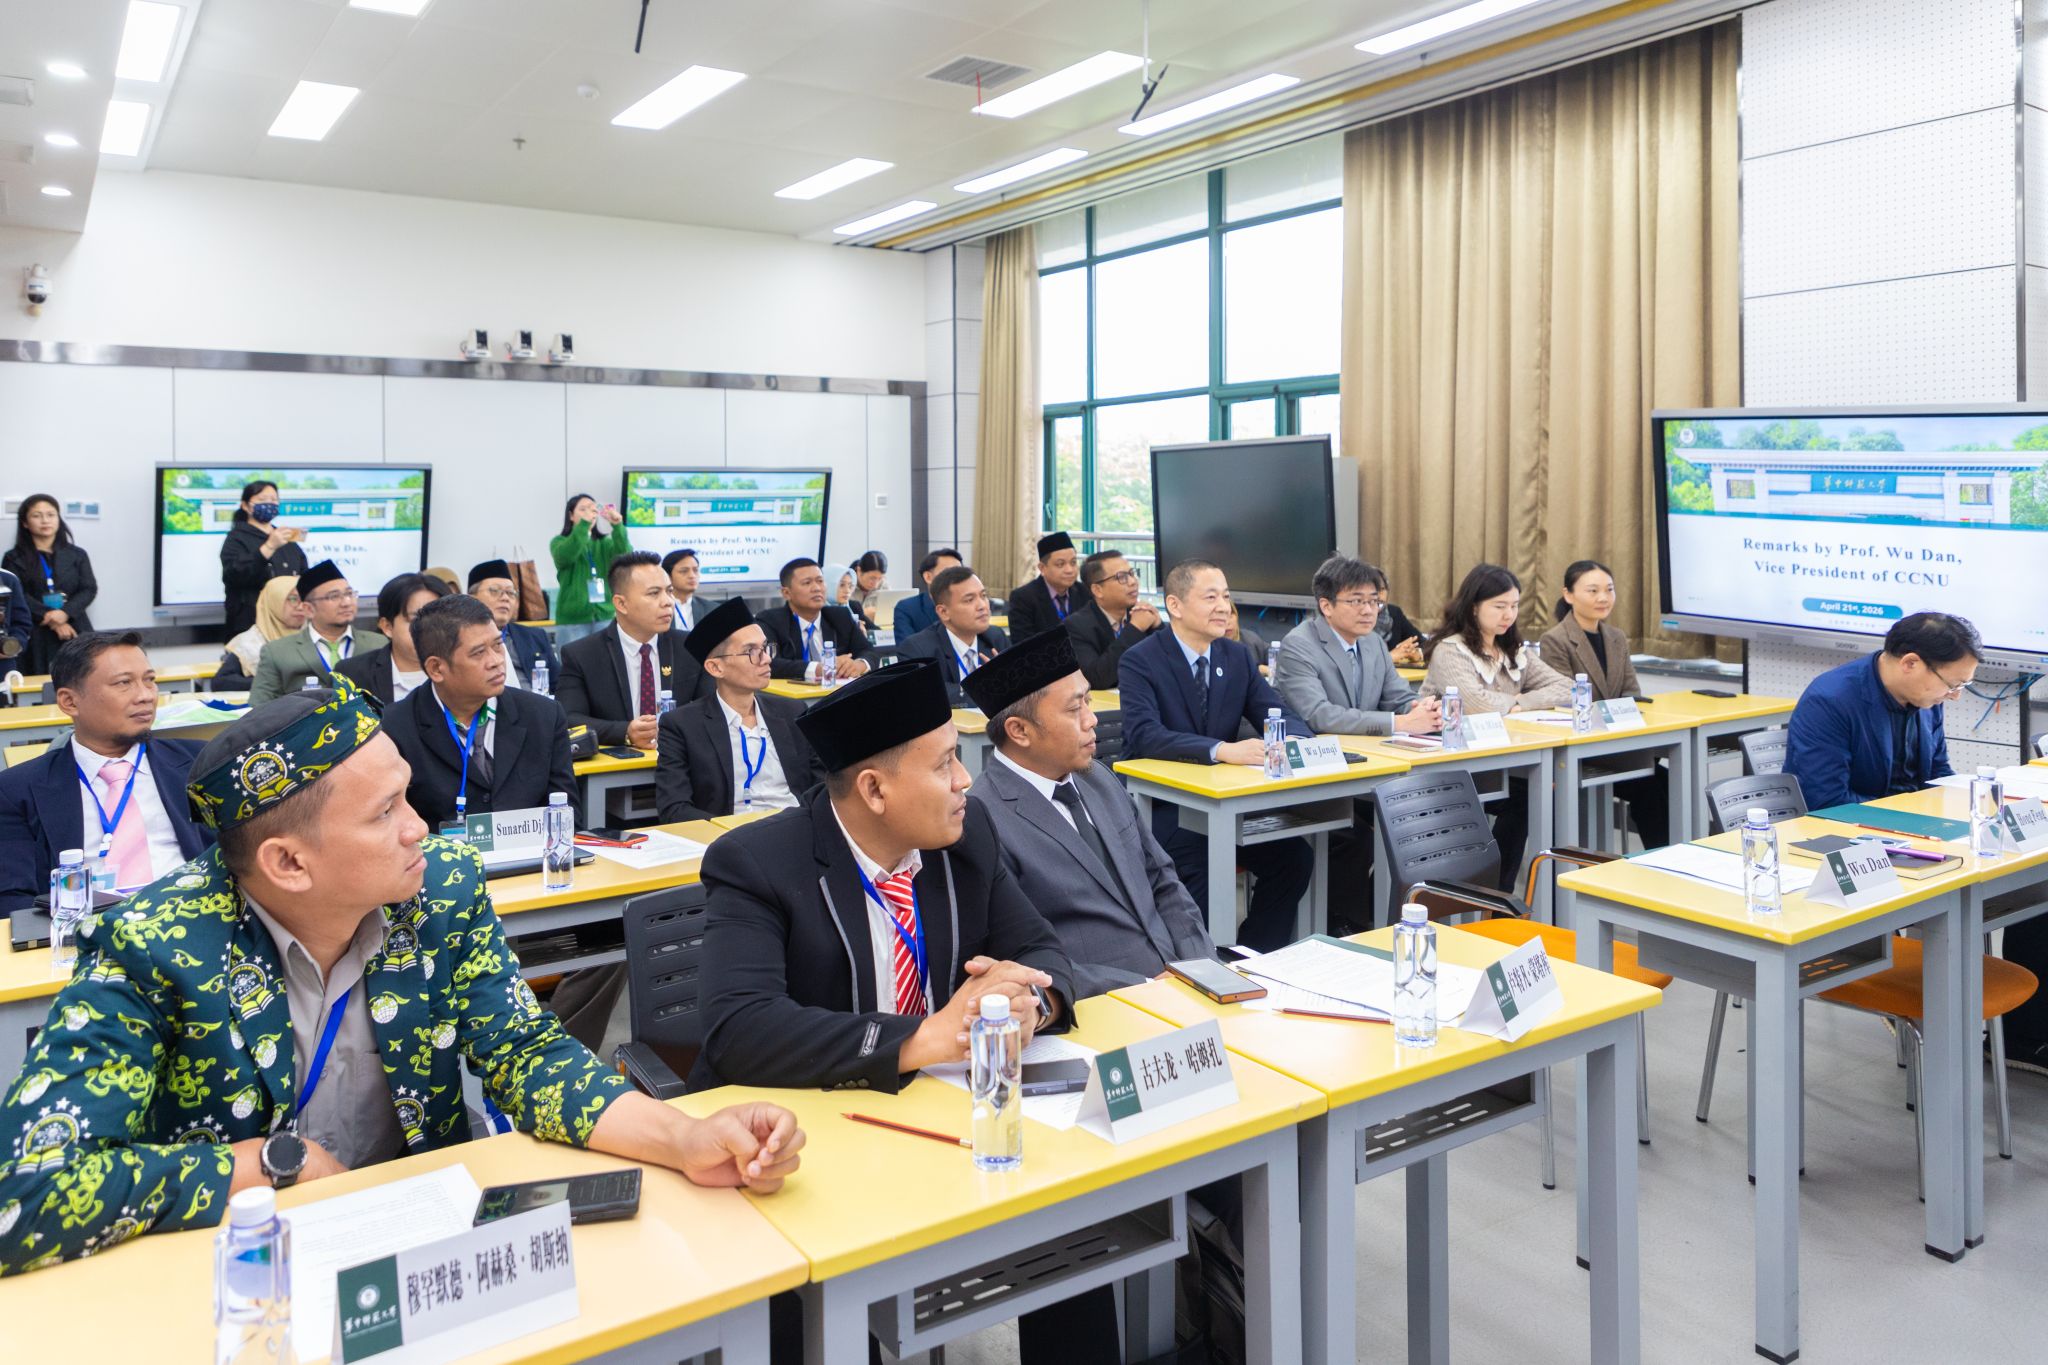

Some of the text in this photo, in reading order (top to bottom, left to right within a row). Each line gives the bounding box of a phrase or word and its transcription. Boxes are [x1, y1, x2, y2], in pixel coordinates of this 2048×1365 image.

[671, 537, 706, 545] Remarks
[1743, 538, 1963, 565] Remarks by Prof. Wu Dan,
[1754, 561, 1950, 587] Vice President of CCNU
[1820, 602, 1841, 612] April
[1862, 605, 1884, 615] 2026
[1305, 746, 1318, 757] Wu
[496, 821, 530, 837] Sunardi
[1848, 857, 1890, 877] Wu Dan
